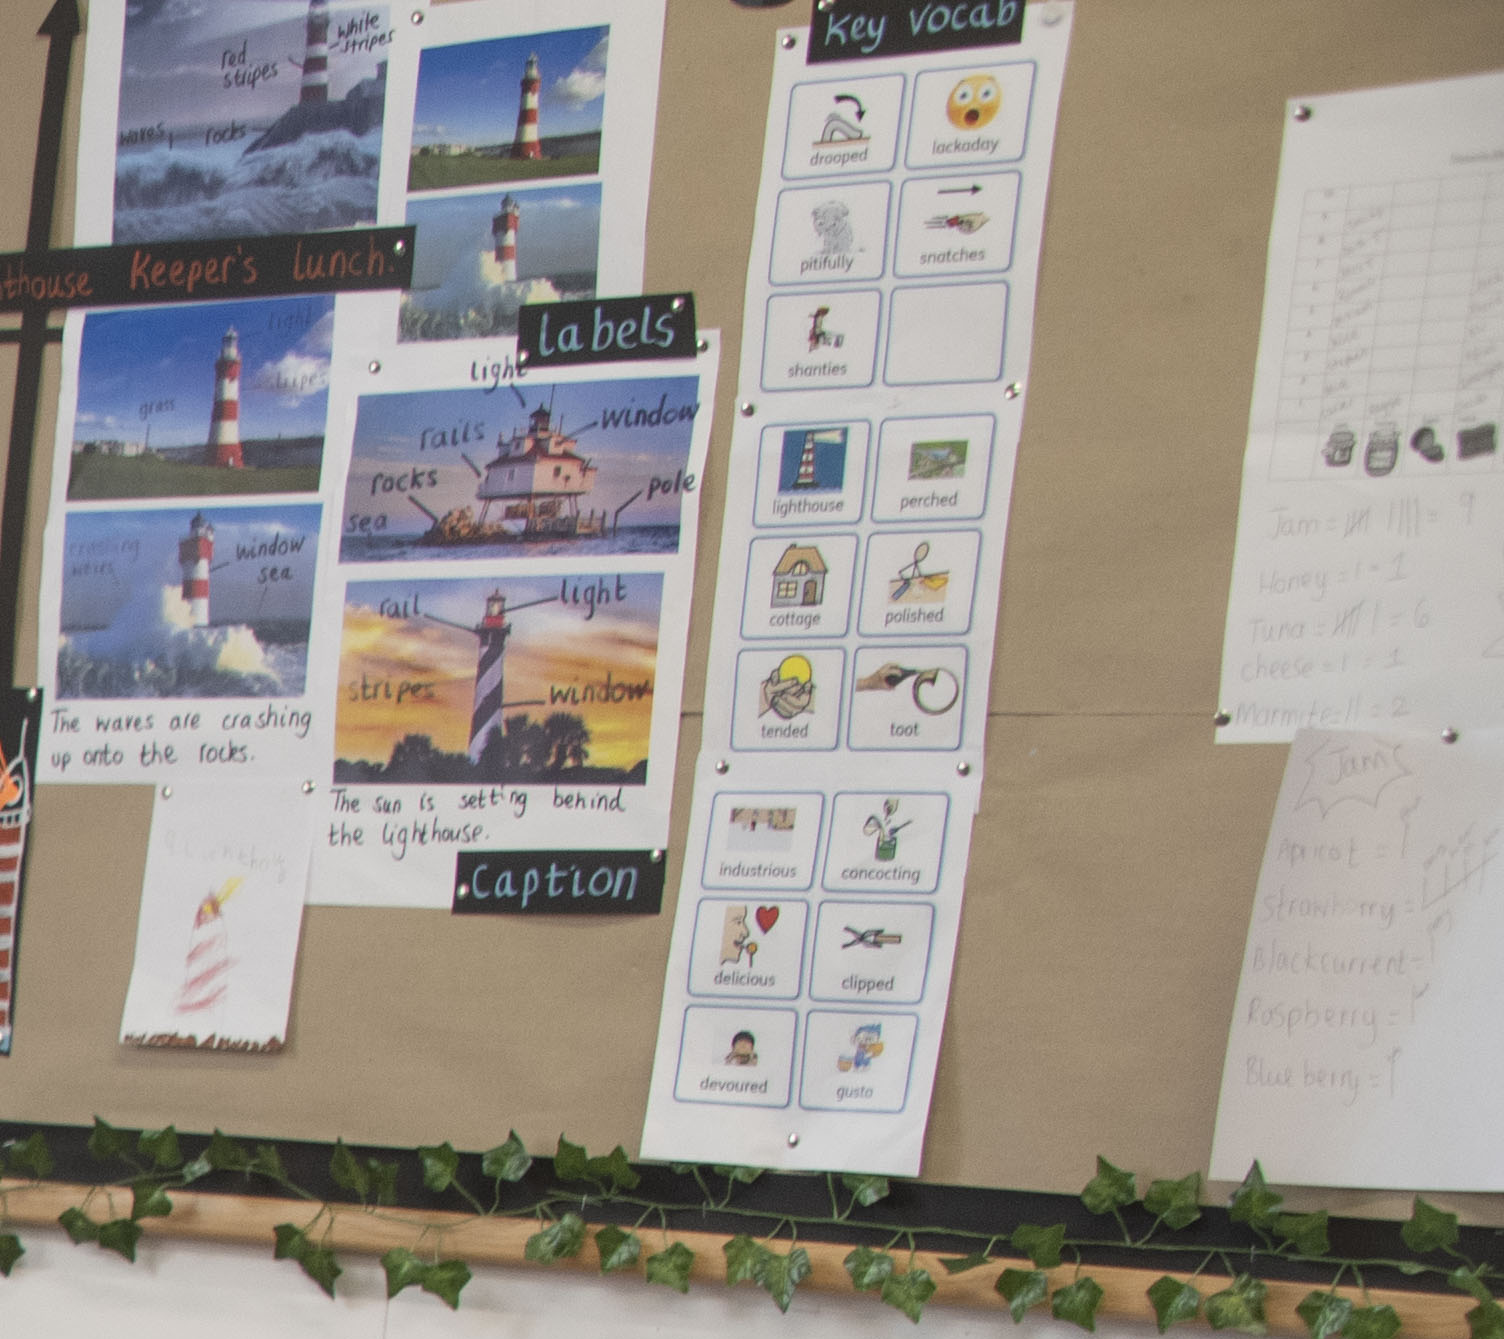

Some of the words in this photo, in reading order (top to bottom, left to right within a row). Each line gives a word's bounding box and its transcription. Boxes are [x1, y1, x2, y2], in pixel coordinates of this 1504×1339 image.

[220, 39, 248, 72] red
[223, 61, 279, 91] stripes
[204, 119, 247, 147] rocks
[932, 137, 1000, 155] lackaday
[810, 148, 869, 168] drooped
[800, 254, 855, 275] pitifully
[919, 247, 986, 265] snatches
[538, 304, 676, 357] labels
[788, 362, 847, 378] shanties
[602, 392, 701, 431] window
[420, 420, 486, 452] rails
[371, 466, 438, 496] rocks
[646, 469, 697, 500] pole
[772, 497, 844, 518] lighthouse
[900, 492, 959, 512] perched
[347, 513, 387, 533] sea
[236, 531, 306, 562] window
[257, 565, 295, 585] sea
[379, 594, 420, 619] rail
[560, 574, 628, 621] light
[769, 613, 821, 630] cottage
[885, 608, 945, 628] polished
[348, 674, 436, 704] stripes
[550, 671, 654, 705] window
[51, 708, 81, 734] The
[96, 712, 154, 733] waves
[169, 712, 201, 731] are
[221, 703, 312, 739] crashing
[761, 724, 809, 739] tended
[890, 722, 920, 737] toot
[51, 751, 71, 772] up
[83, 743, 124, 767] onto
[140, 741, 178, 767] the
[199, 740, 255, 764] rocks.
[329, 787, 361, 813] The
[372, 794, 402, 814] sun
[419, 792, 434, 812] is
[458, 783, 529, 818] setting
[552, 785, 626, 812] behind
[328, 821, 364, 846] the
[719, 861, 797, 879] industrious
[841, 866, 921, 885] concocting
[713, 971, 776, 987] delicious
[841, 976, 896, 995] clipped
[699, 1076, 769, 1095] devoured
[836, 1085, 874, 1102] gusto
